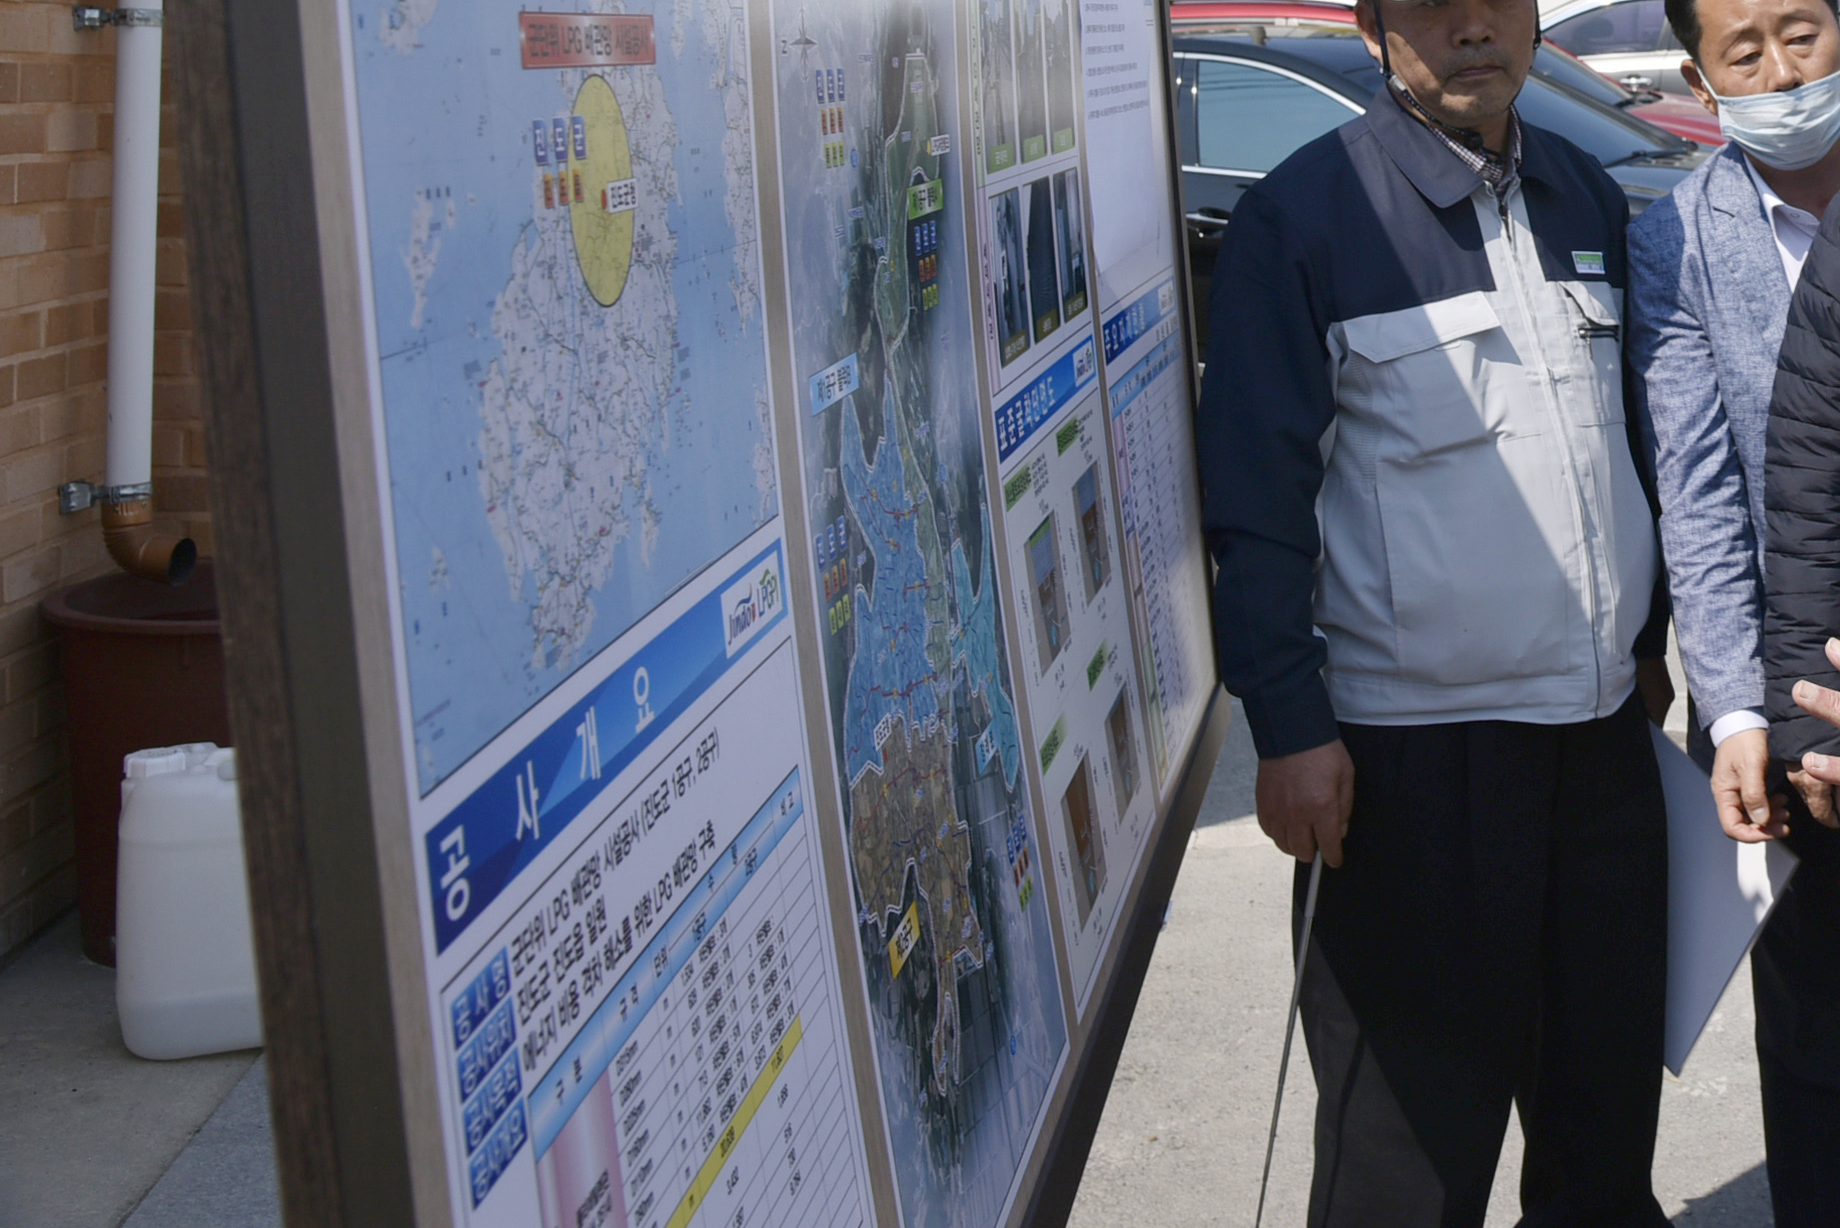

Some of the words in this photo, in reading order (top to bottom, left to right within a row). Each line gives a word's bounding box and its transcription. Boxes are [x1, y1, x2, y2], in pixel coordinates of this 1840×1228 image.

[563, 25, 583, 55] LPG
[512, 916, 545, 977] 군단위
[549, 889, 570, 936] LPG
[571, 854, 601, 905] 배관망
[605, 812, 639, 870] 시설공사
[642, 779, 670, 835] (진도군
[672, 756, 696, 798] 1공구,
[696, 732, 718, 774] 2공구)
[523, 1007, 557, 1071] 에너지
[559, 980, 579, 1026] 비용
[581, 952, 602, 995] 격차
[604, 916, 633, 971] 해소를
[634, 893, 653, 936] 위한
[654, 872, 672, 914] LPG
[673, 843, 697, 887] 배관망
[699, 820, 715, 851] 구축
[517, 961, 551, 1026] 진도군
[553, 922, 584, 983] 진도읍
[586, 899, 607, 945] 일원
